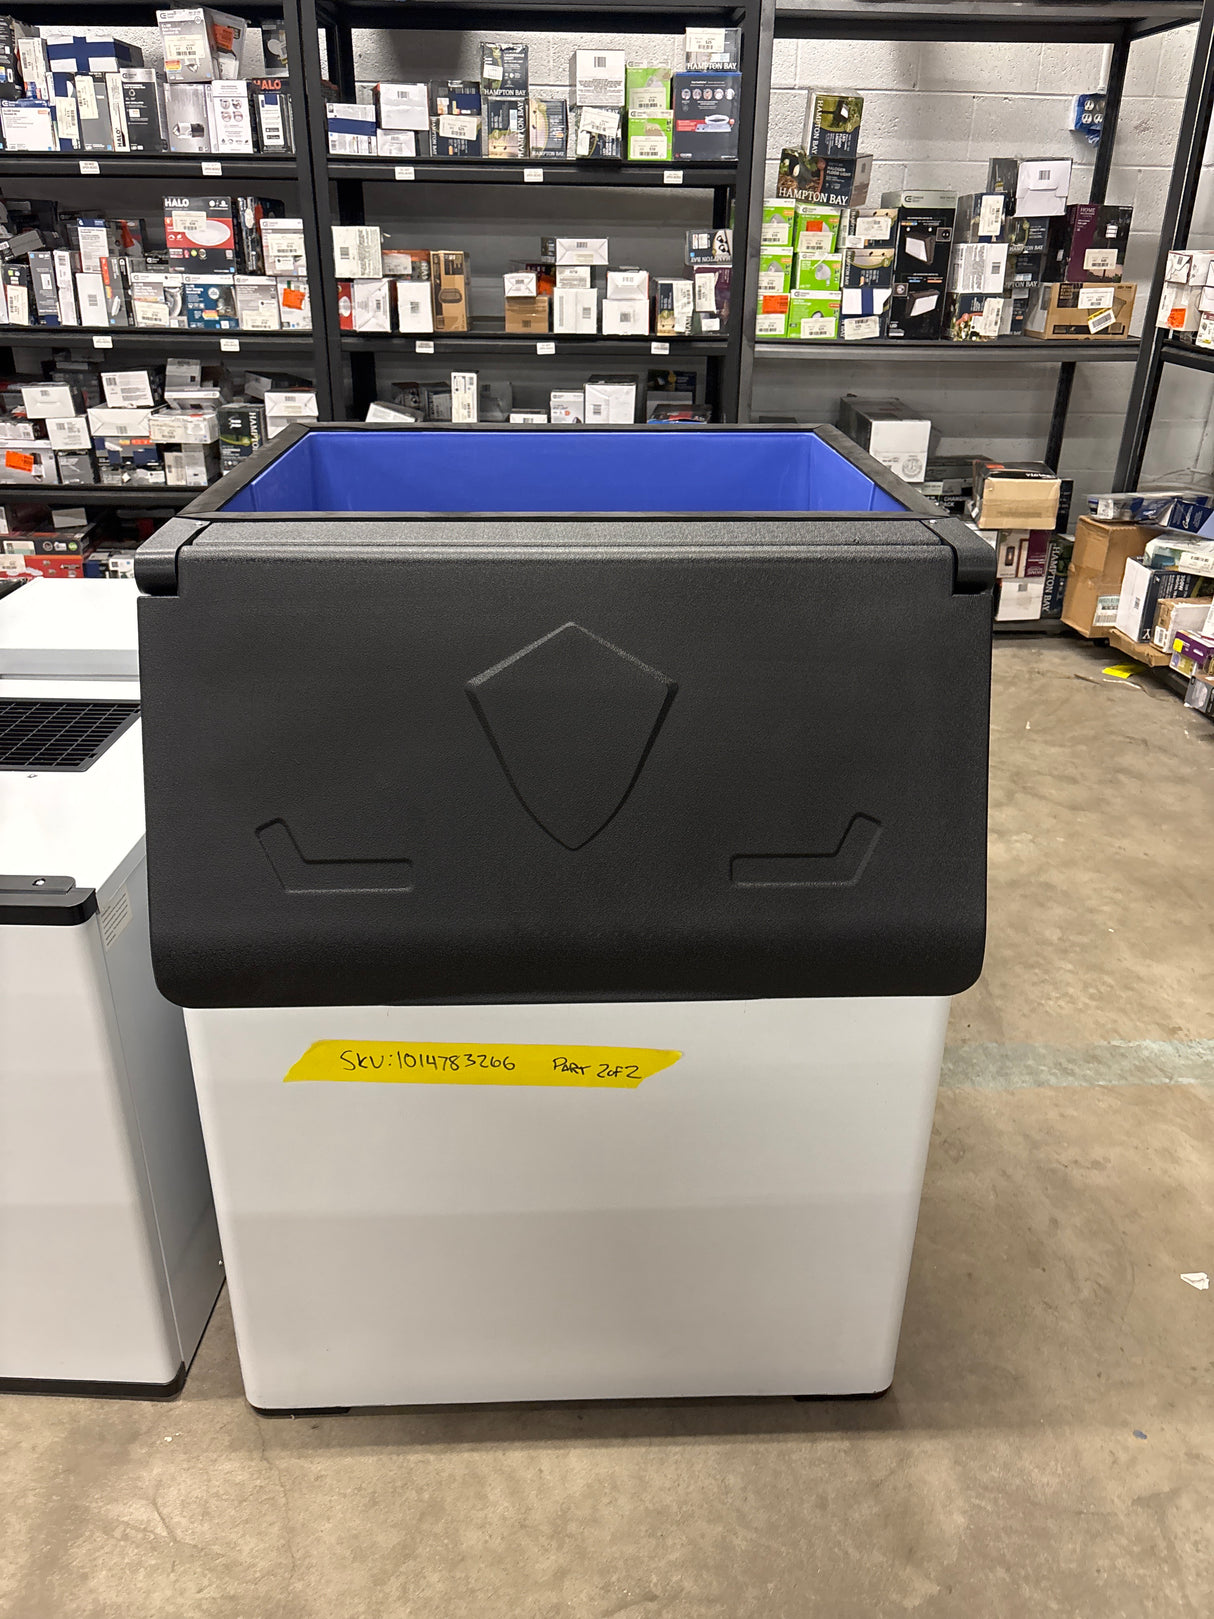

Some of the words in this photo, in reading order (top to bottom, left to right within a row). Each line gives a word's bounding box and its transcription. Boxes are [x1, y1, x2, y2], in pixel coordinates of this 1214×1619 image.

[687, 62, 723, 70] HAMPTON
[723, 62, 737, 70] BAY
[484, 88, 514, 96] HAMPTON
[812, 100, 824, 139] HAMPTON
[811, 140, 819, 154] BAY
[164, 198, 190, 207] HALO
[778, 187, 828, 203] HAMPTON
[829, 194, 849, 205] BAY
[249, 412, 258, 450] HAMPTO
[1046, 546, 1061, 594] HAMPTON
[1042, 594, 1052, 612] BAY
